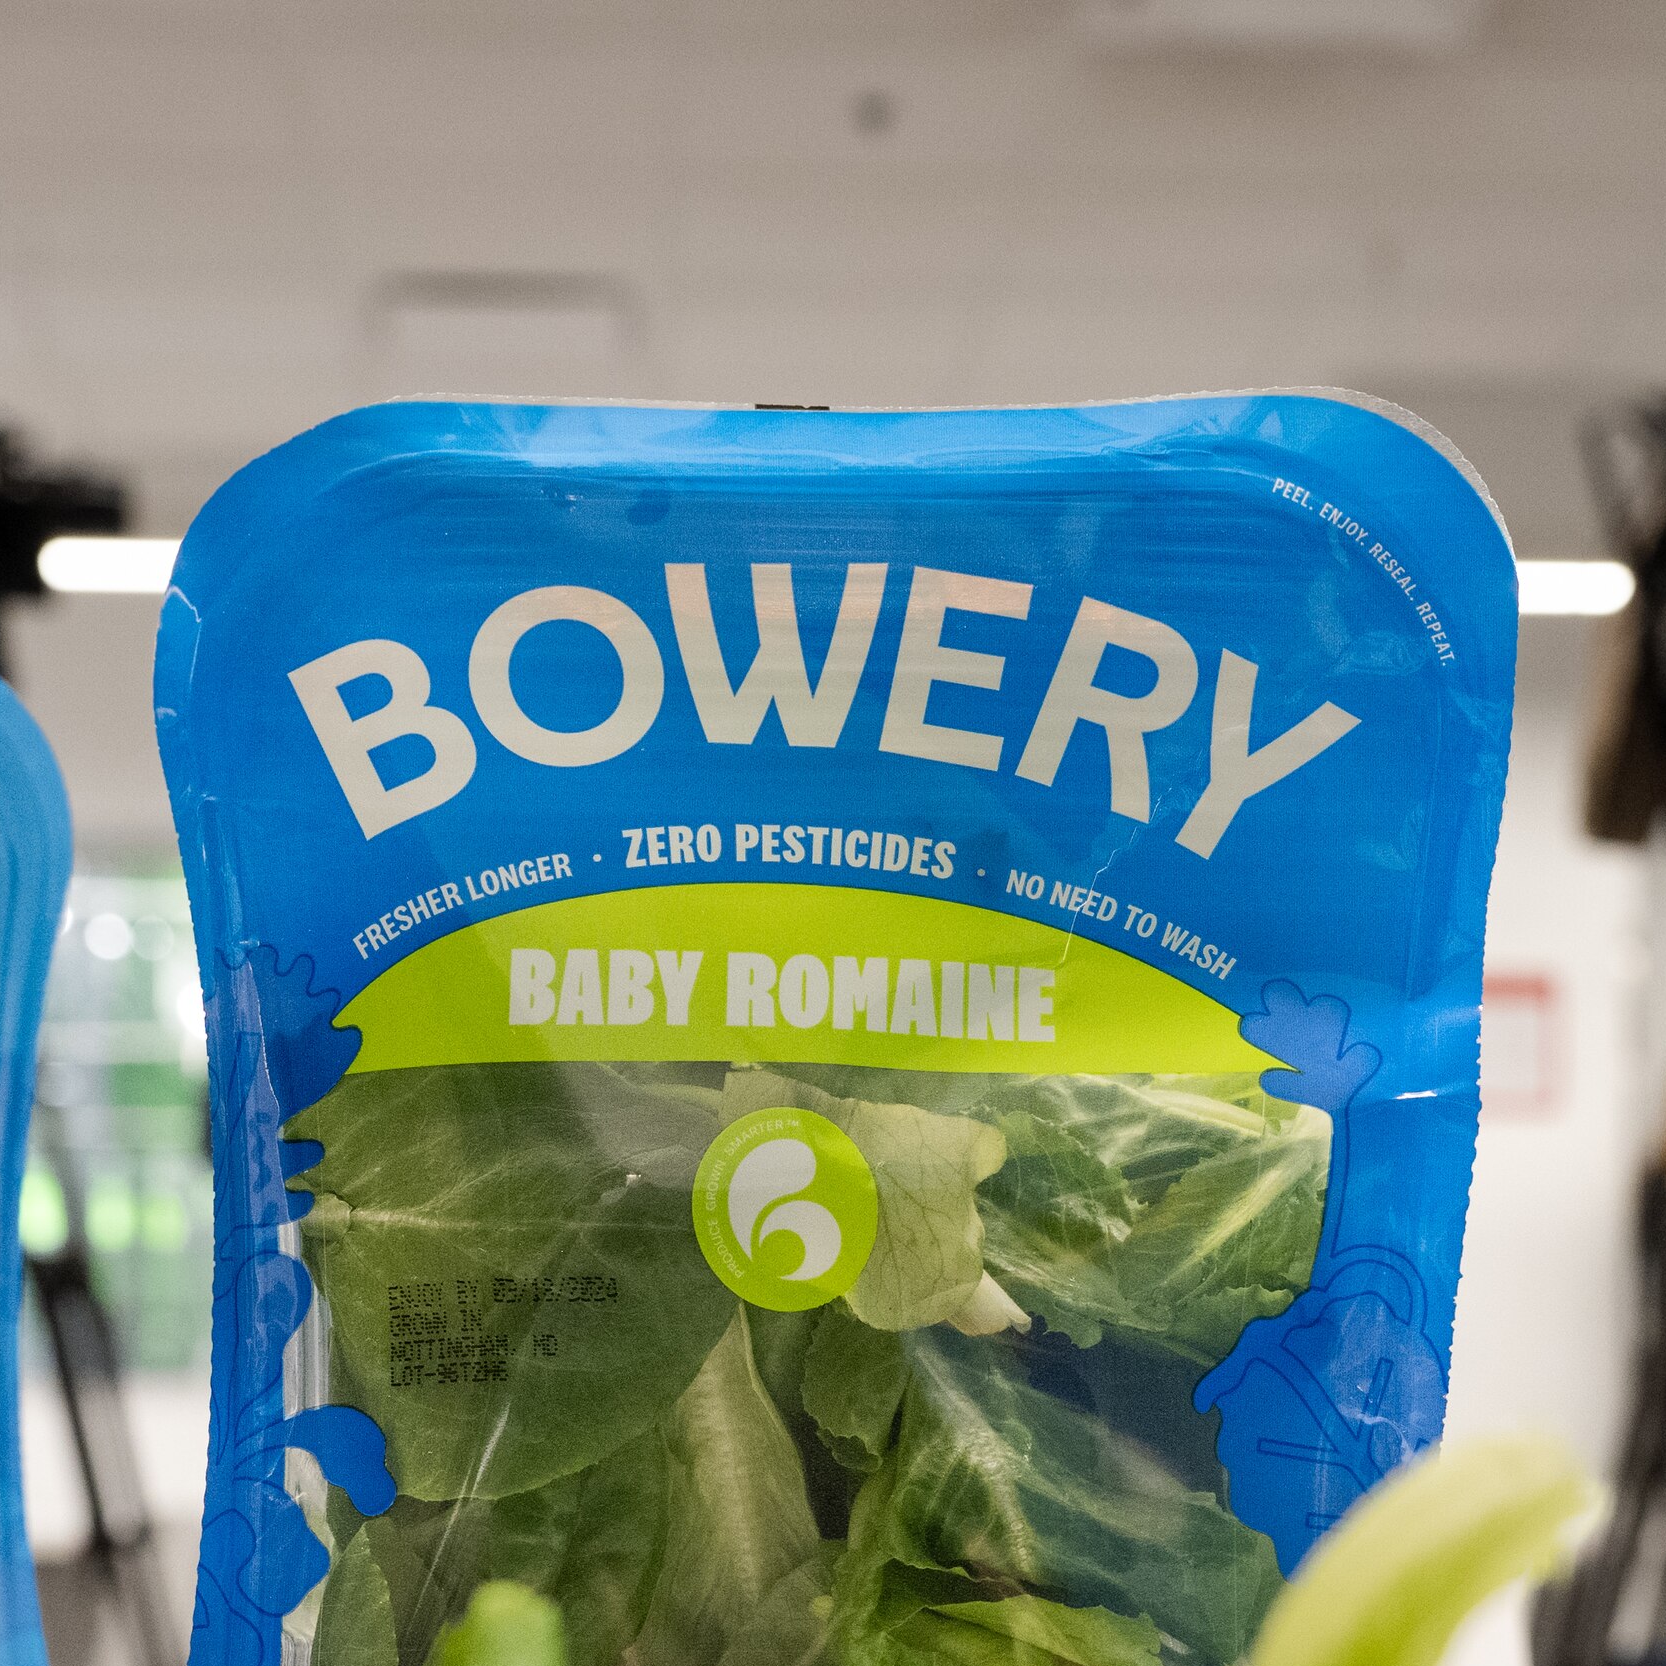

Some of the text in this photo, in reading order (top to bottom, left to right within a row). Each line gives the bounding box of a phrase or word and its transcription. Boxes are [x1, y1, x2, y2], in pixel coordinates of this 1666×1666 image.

[1272, 478, 1455, 666] PEEL. ENJOY. RESEAL. REPEAT.
[286, 561, 1362, 862] BOWERY
[352, 824, 1237, 980] FRESHER LONGER ZERO PESTICIDES NO NEED TO WASH
[509, 949, 1056, 1043] BABY ROMAINE
[705, 1160, 727, 1211] GROWN
[388, 1283, 443, 1311] ENJOY
[457, 1279, 479, 1304] BY
[390, 1309, 482, 1335] GROWN IN
[533, 1334, 558, 1357] MD
